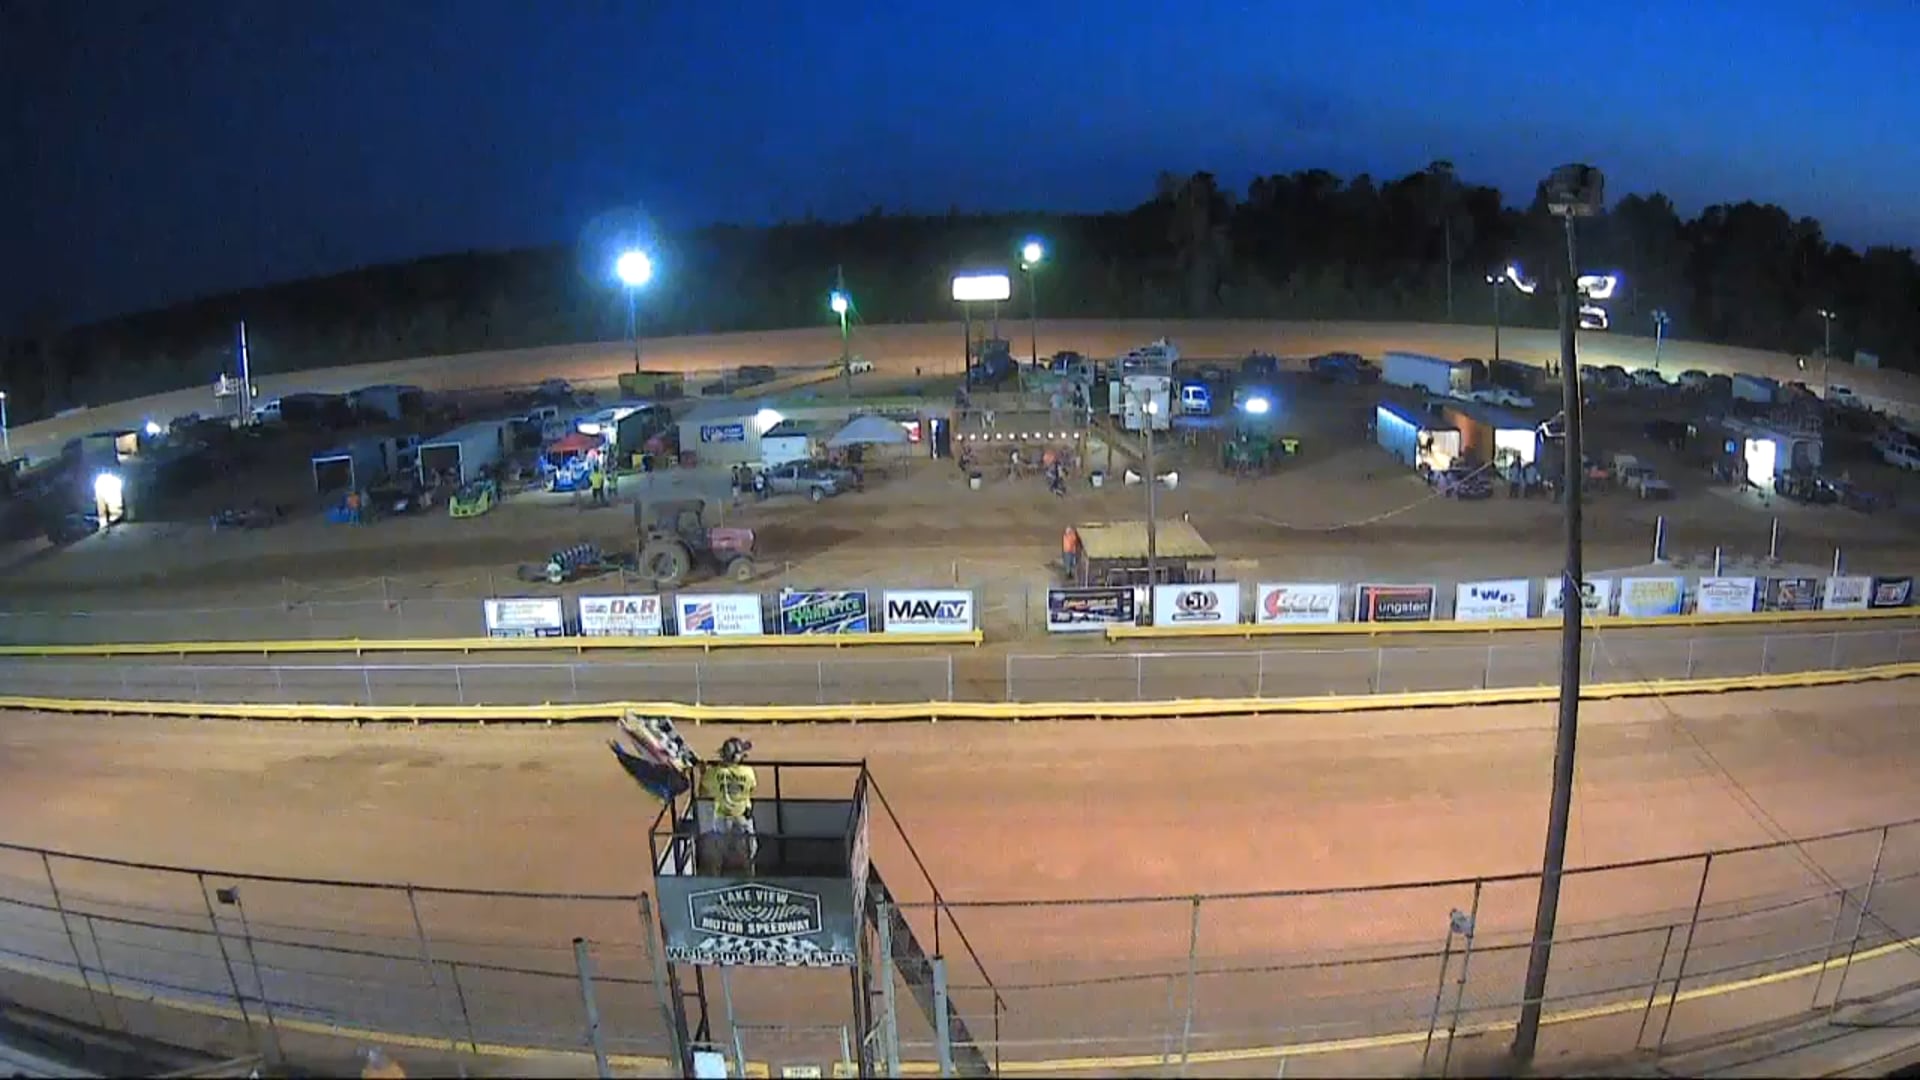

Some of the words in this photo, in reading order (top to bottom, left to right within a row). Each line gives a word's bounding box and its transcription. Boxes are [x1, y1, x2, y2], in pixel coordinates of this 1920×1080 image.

[889, 599, 967, 619] MAVTV
[719, 889, 751, 903] LAKE
[755, 889, 789, 903] VIEW
[702, 917, 744, 934] MOTOR
[747, 918, 811, 934] SPEEDWAY
[666, 946, 750, 961] Welcome
[754, 948, 803, 961] Race
[809, 948, 856, 961] Fans
